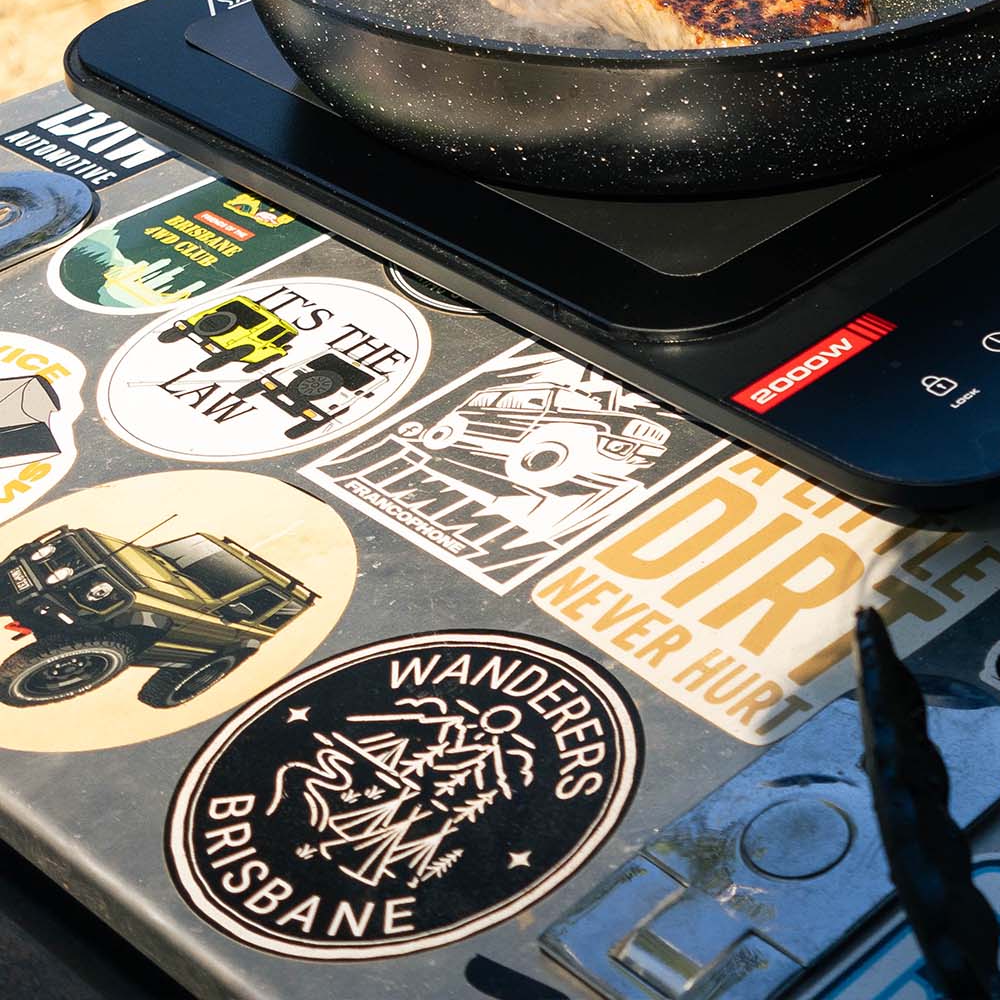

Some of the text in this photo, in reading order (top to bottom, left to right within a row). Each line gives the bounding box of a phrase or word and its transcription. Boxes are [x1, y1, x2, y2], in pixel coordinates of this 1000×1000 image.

[4, 130, 118, 185] AUTOMOTIVE
[144, 226, 218, 267] 4WD CLUB
[164, 215, 243, 257] BRISBANE
[255, 286, 411, 375] IT'S THE
[157, 369, 259, 424] LAW
[750, 337, 854, 405] 2000W
[950, 387, 981, 409] LOCK
[344, 479, 467, 553] FRANCOPHONE
[593, 476, 948, 687] DIRT
[537, 566, 812, 735] NEVER HURT
[389, 654, 607, 800] WANDERERS
[205, 793, 418, 937] BRISBANE
